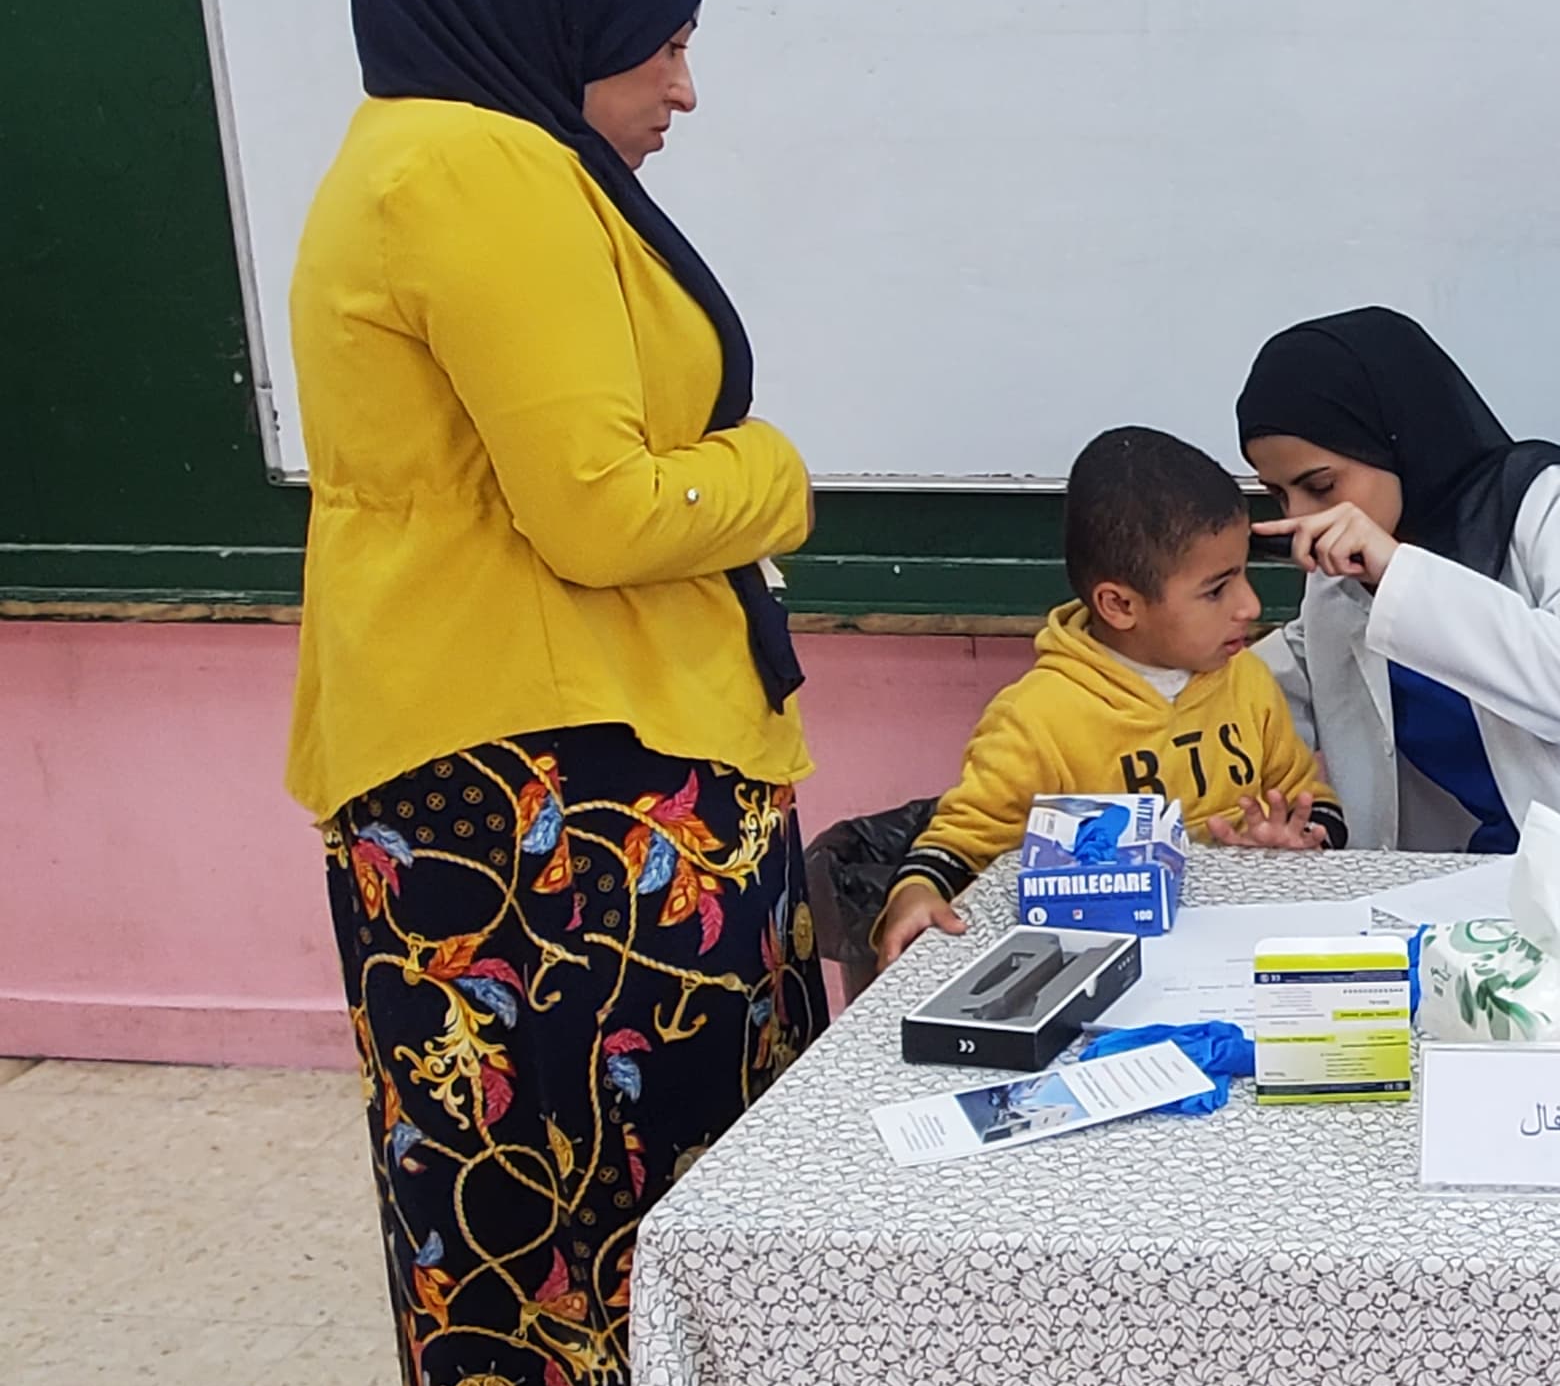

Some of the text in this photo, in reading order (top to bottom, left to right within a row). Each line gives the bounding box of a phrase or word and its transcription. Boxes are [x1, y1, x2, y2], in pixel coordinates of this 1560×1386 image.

[1120, 723, 1255, 811] BTS
[1023, 872, 1152, 897] NITRILECARE
[1133, 910, 1153, 921] 100
